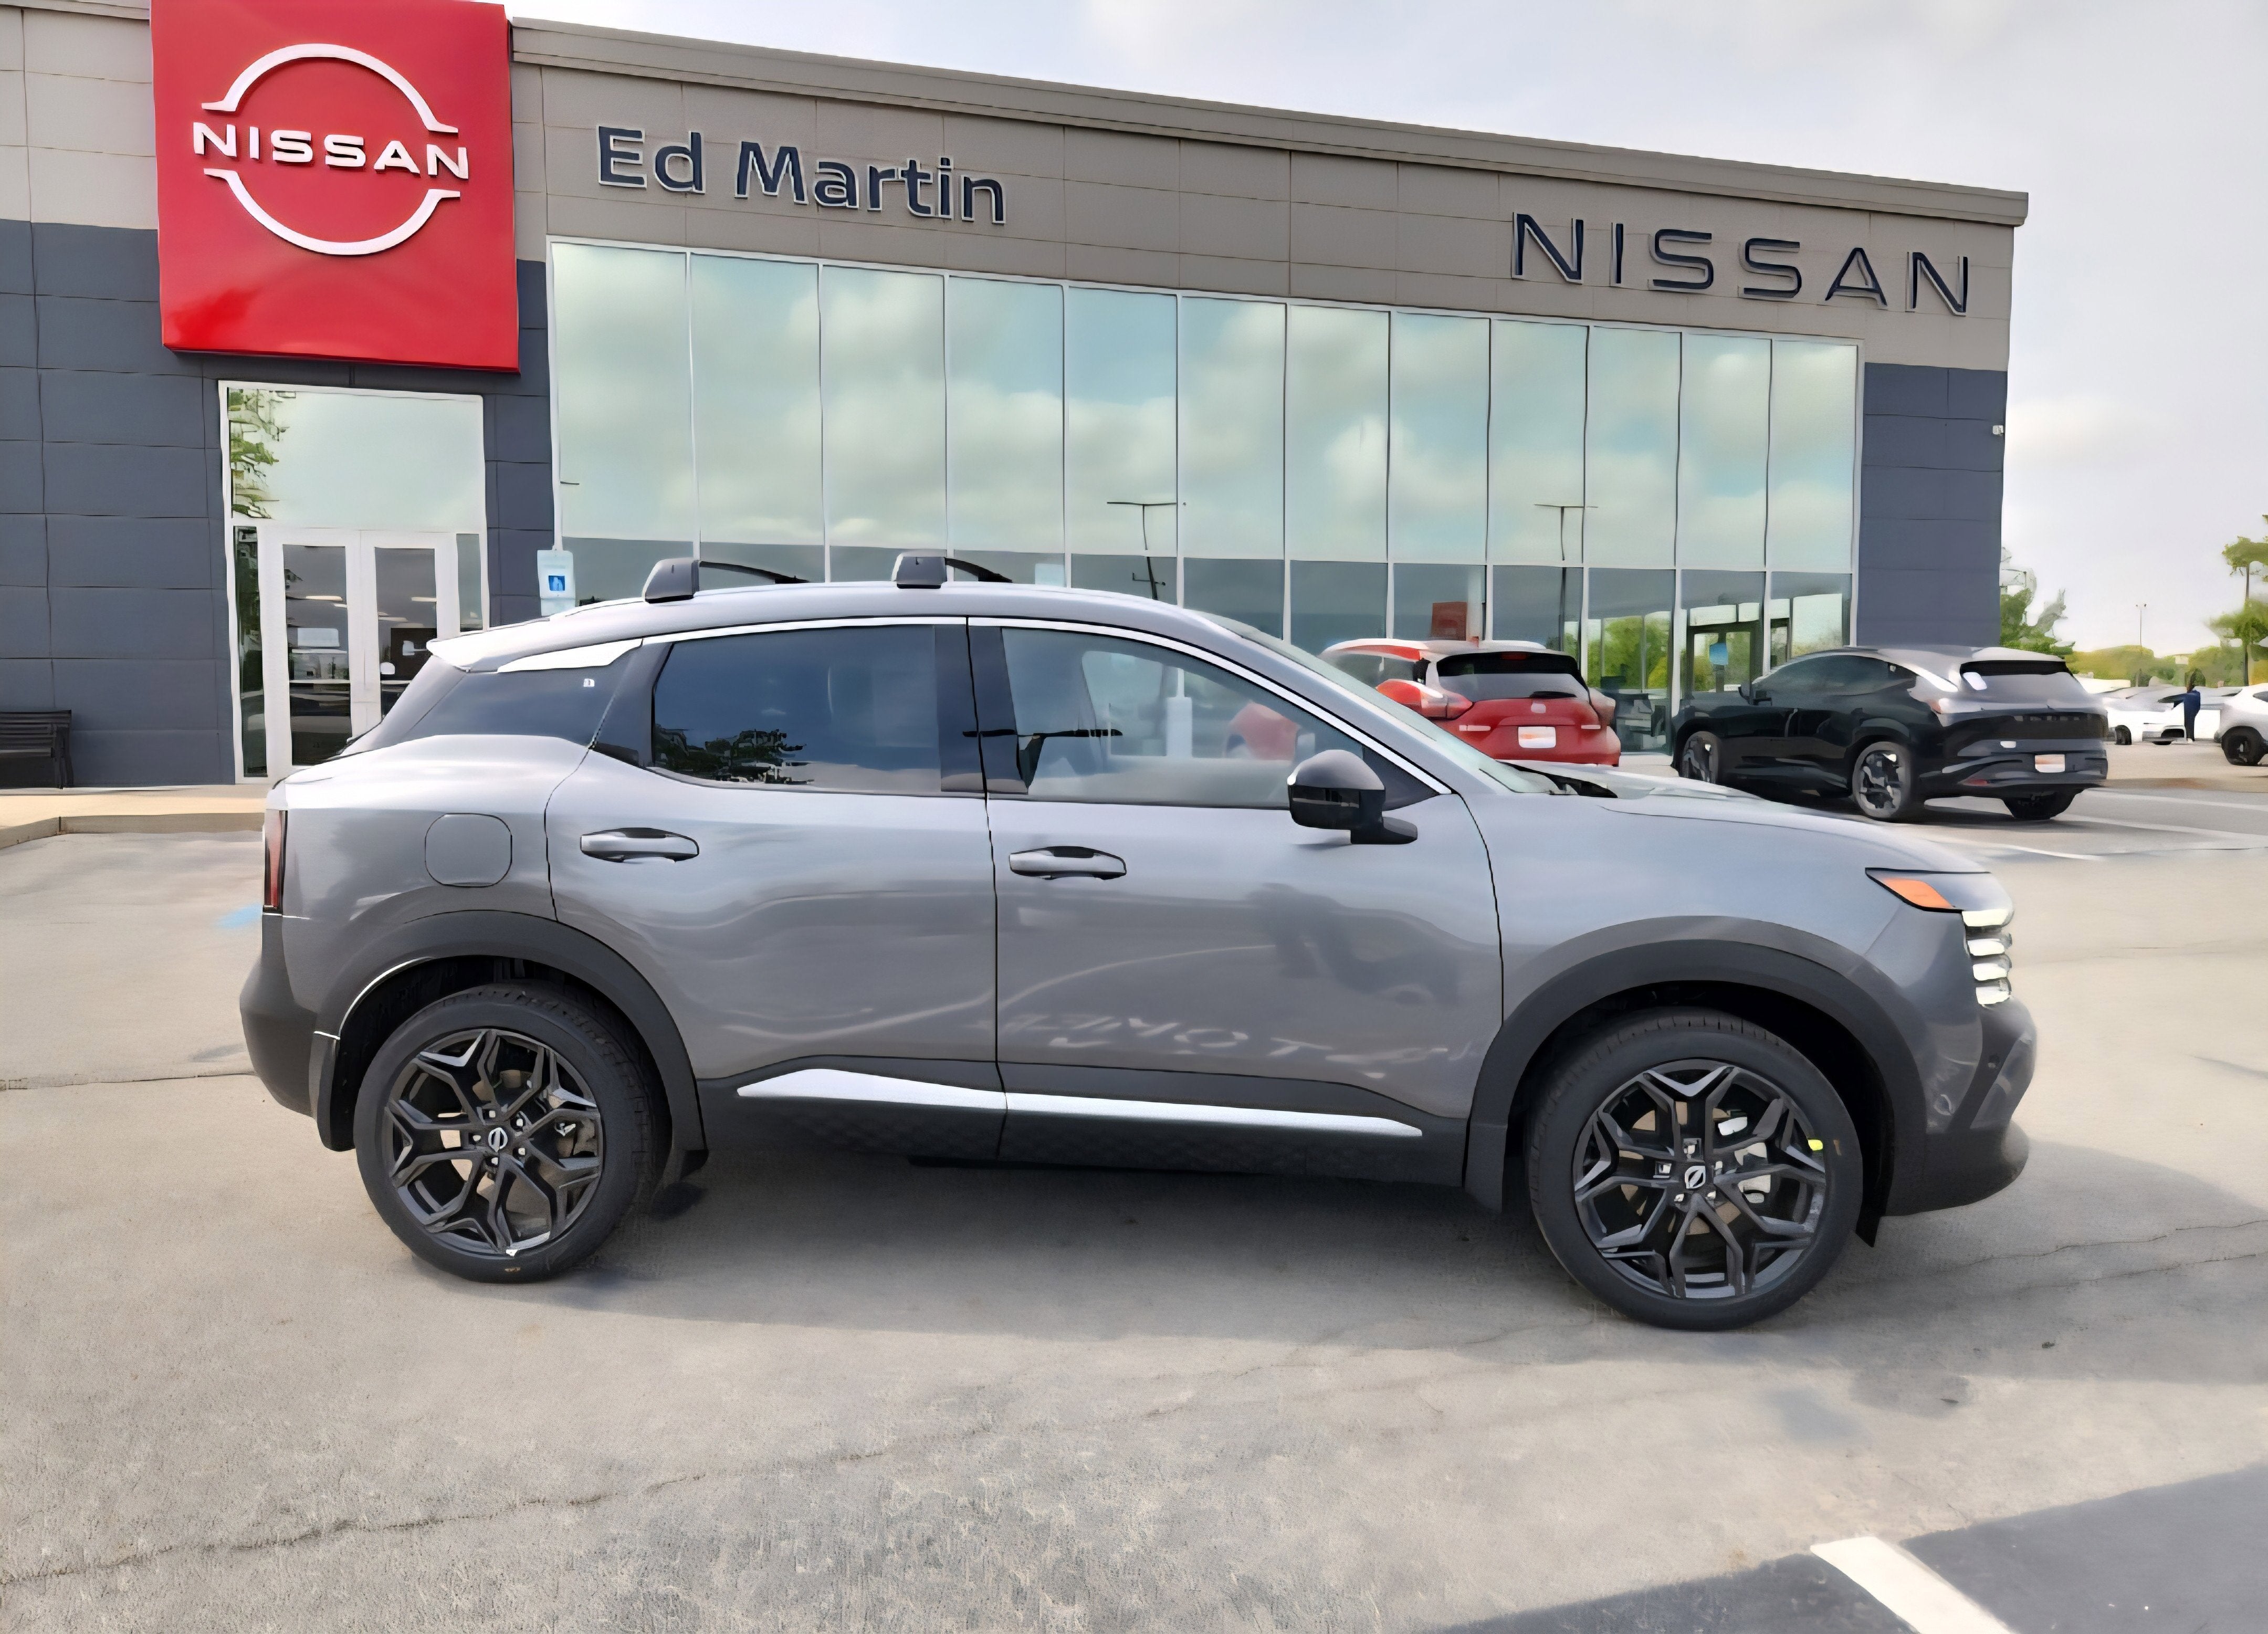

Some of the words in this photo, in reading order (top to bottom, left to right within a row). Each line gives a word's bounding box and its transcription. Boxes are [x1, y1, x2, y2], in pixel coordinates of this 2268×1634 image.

[193, 121, 469, 180] NISSAN
[596, 124, 707, 194] Ed
[734, 139, 1007, 225] Martin
[1512, 211, 1969, 316] NISSAN
